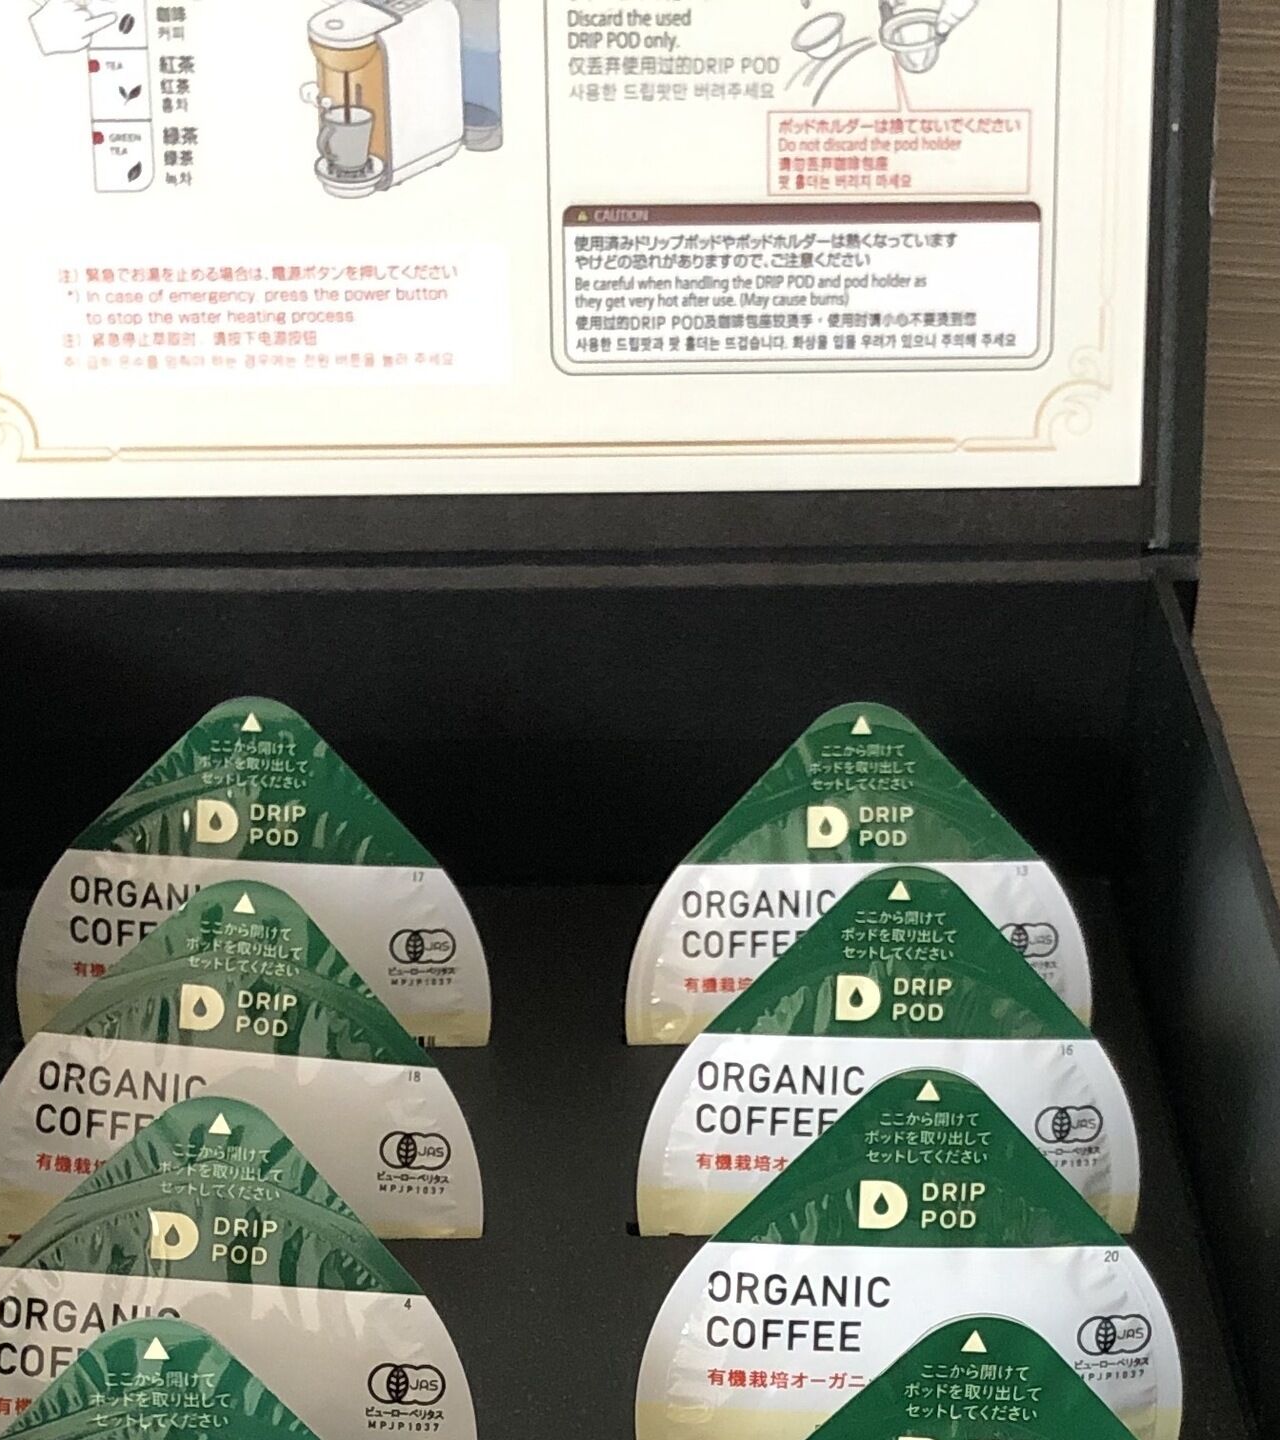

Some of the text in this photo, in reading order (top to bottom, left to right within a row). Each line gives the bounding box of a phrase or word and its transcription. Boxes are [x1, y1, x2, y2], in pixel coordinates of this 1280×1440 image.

[568, 9, 691, 27] Discard the used
[568, 32, 680, 52] DRIP POD only.
[741, 57, 779, 74] POD
[779, 138, 961, 153] Do not discard the pod holder
[594, 210, 648, 222] CAUTION
[575, 274, 927, 293] Be careful when handling the DRIP POD and pod holder as
[105, 292, 143, 303] case
[148, 289, 163, 303] of
[265, 290, 308, 303] press
[315, 288, 339, 301] the
[345, 289, 390, 302] power
[396, 288, 447, 301] button
[576, 294, 601, 309] they
[606, 296, 625, 311] get
[629, 296, 654, 310] very
[658, 293, 678, 307] hot
[681, 293, 709, 307] after
[740, 292, 768, 309] (May
[772, 294, 807, 307] cause
[86, 313, 102, 324] to
[107, 313, 143, 325] stop
[148, 312, 173, 324] the
[178, 313, 221, 324] water
[227, 310, 286, 325] heating
[210, 740, 297, 756] ここから開けて
[821, 745, 904, 758] ここから開けて
[201, 771, 307, 789] セットしてください
[811, 778, 914, 791] セットしてください
[250, 804, 307, 823] DRIP
[859, 806, 914, 823] DRIP
[250, 829, 300, 847] POD
[859, 830, 908, 847] POD
[854, 911, 947, 925] ここから開けて
[199, 920, 292, 941] ここから開けて
[841, 928, 959, 944] ポッドを取り出して
[186, 938, 303, 960] ポッドを取り出して
[842, 946, 953, 961] セットしてください
[188, 956, 300, 976] セットしてください
[893, 978, 952, 996] DRIP
[238, 991, 298, 1010] DRIP
[892, 1004, 943, 1022] POD
[236, 1015, 288, 1037] POD
[1061, 1045, 1073, 1055] 16
[409, 1071, 421, 1082] 18
[698, 1061, 865, 1096] ORGANIC
[879, 1111, 979, 1127] ここから開けて
[864, 1130, 991, 1147] ポッドを取り出して
[171, 1146, 270, 1163] ここから開けて
[418, 1147, 444, 1157] JAS
[867, 1149, 987, 1165] セットしてください
[160, 1181, 280, 1201] セットしてください
[922, 1182, 986, 1202] DRIP
[213, 1217, 278, 1238] DRIP
[921, 1209, 977, 1229] POD
[212, 1244, 268, 1265] POD
[1104, 1250, 1119, 1262] 20
[708, 1270, 891, 1308] ORGANIC
[404, 1298, 411, 1309] 4
[707, 1316, 861, 1352] COFFEE
[1117, 1328, 1144, 1340] JAS
[104, 1374, 214, 1390] ここから開けて
[920, 1364, 1030, 1382] ここから開けて
[410, 1379, 438, 1391] JAS
[904, 1383, 1042, 1402] ポッドを取り出して
[93, 1411, 229, 1429] セットしてください
[905, 1404, 1037, 1422] セットしてください
